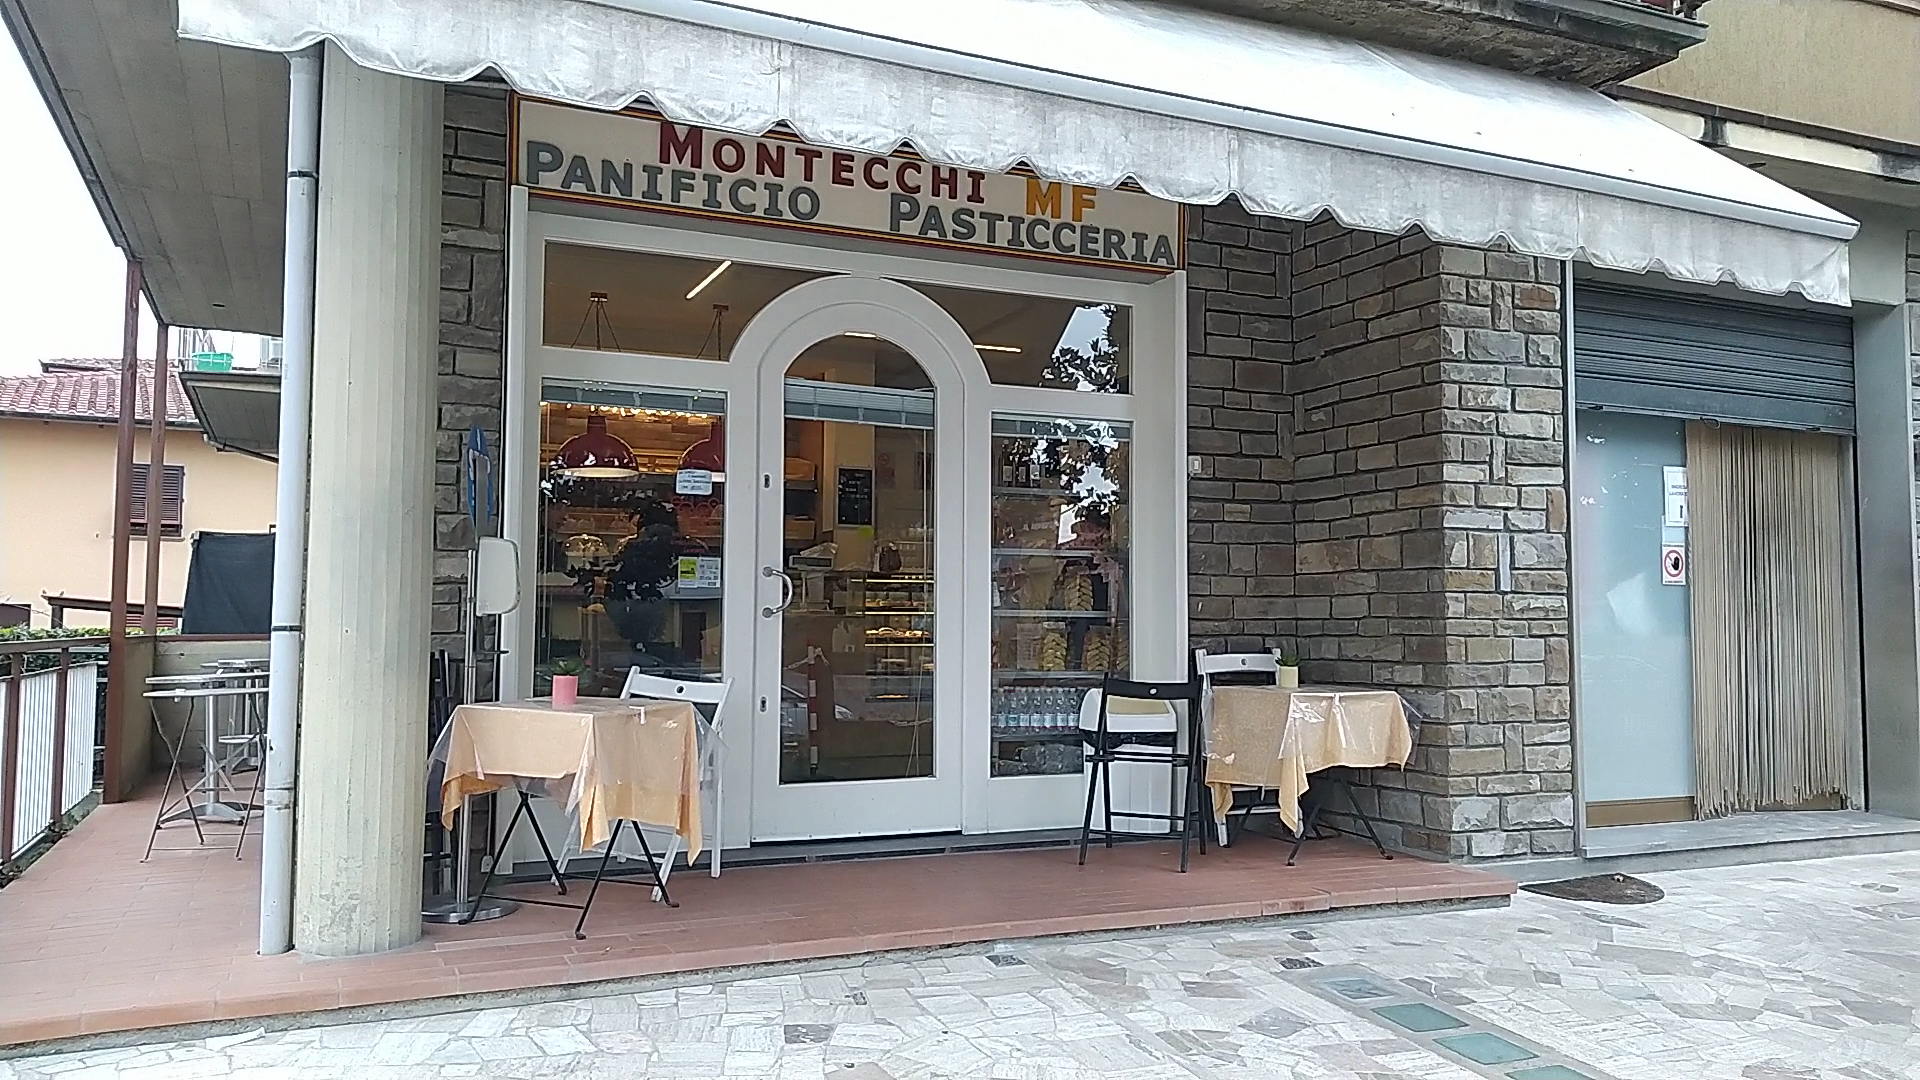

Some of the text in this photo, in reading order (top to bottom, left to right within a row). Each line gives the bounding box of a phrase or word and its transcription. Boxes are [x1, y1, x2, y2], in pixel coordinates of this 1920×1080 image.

[527, 140, 1175, 265] PANIFICIO PASTICCERIA
[659, 121, 1097, 222] MONTECCHI MF
